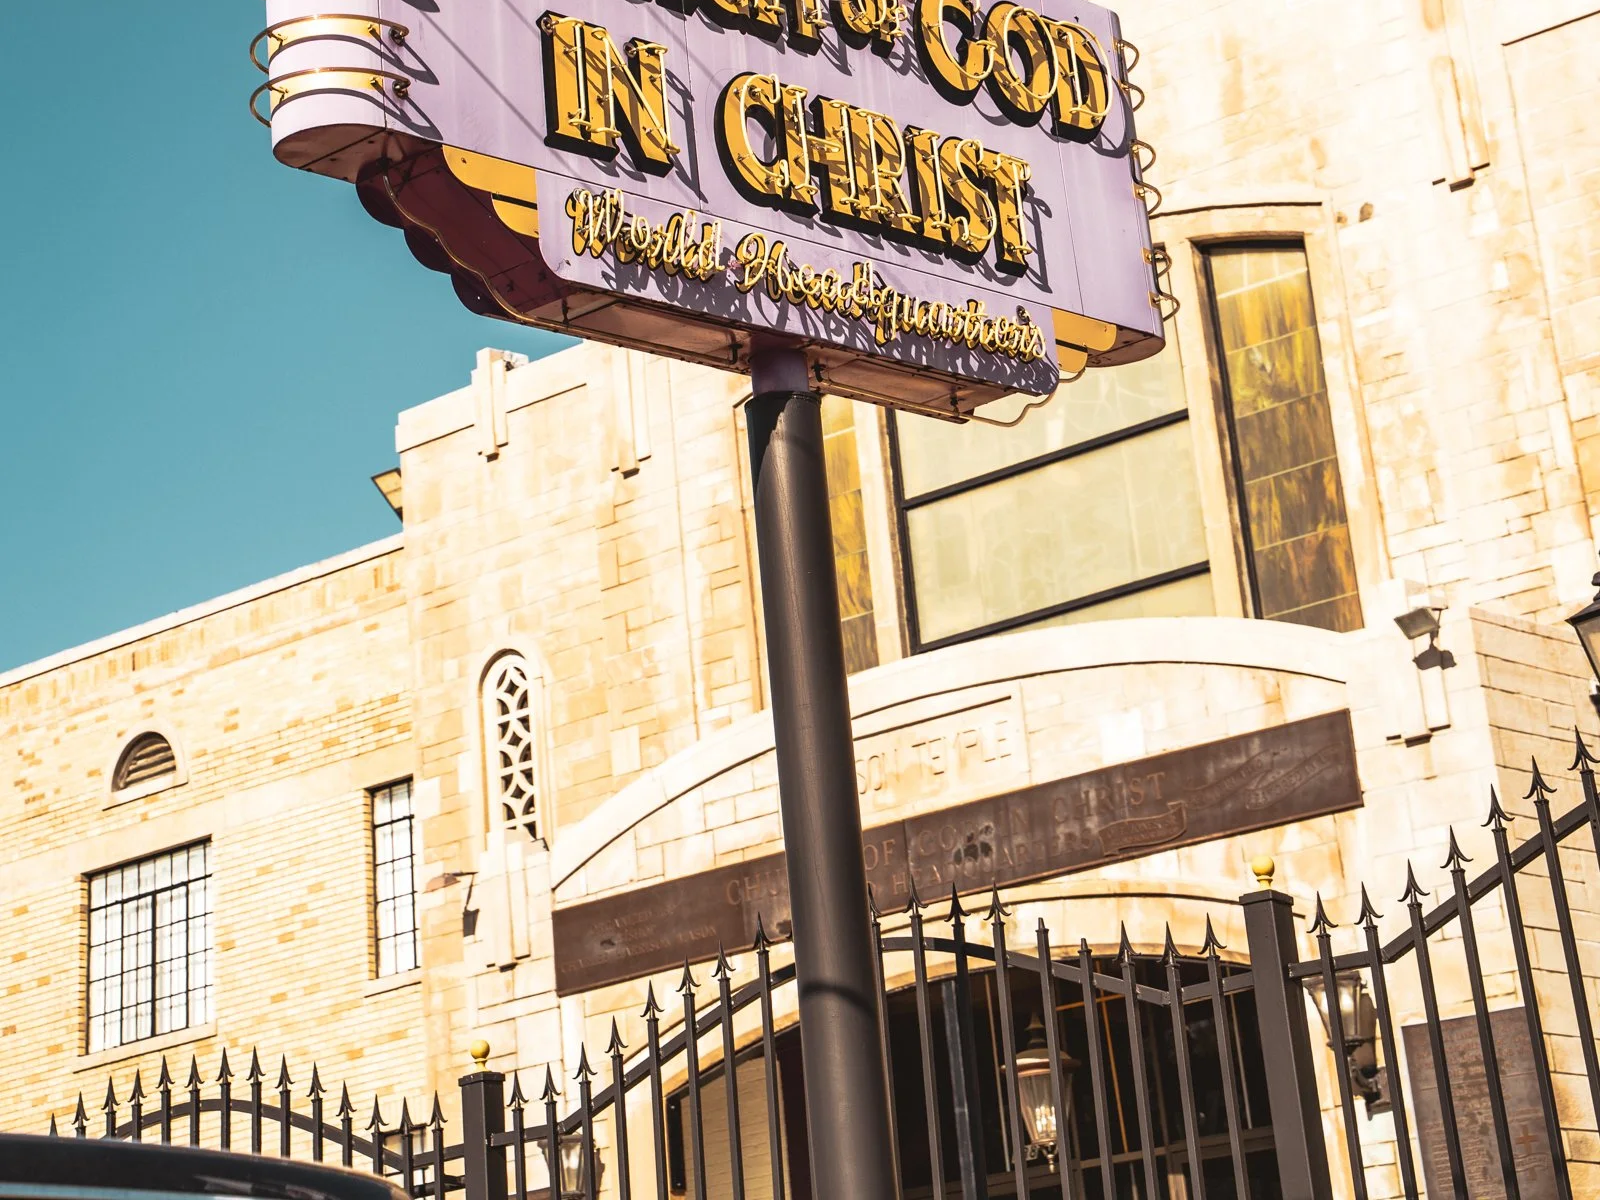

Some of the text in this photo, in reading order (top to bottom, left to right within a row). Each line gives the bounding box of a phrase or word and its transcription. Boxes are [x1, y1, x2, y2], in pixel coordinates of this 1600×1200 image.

[539, 11, 1034, 278] IN CHRIST
[566, 186, 1048, 372] World Headquarters
[725, 866, 788, 907] CHU
[863, 837, 898, 873] OF
[1052, 770, 1167, 826] CHRIST
[855, 746, 903, 796] SON
